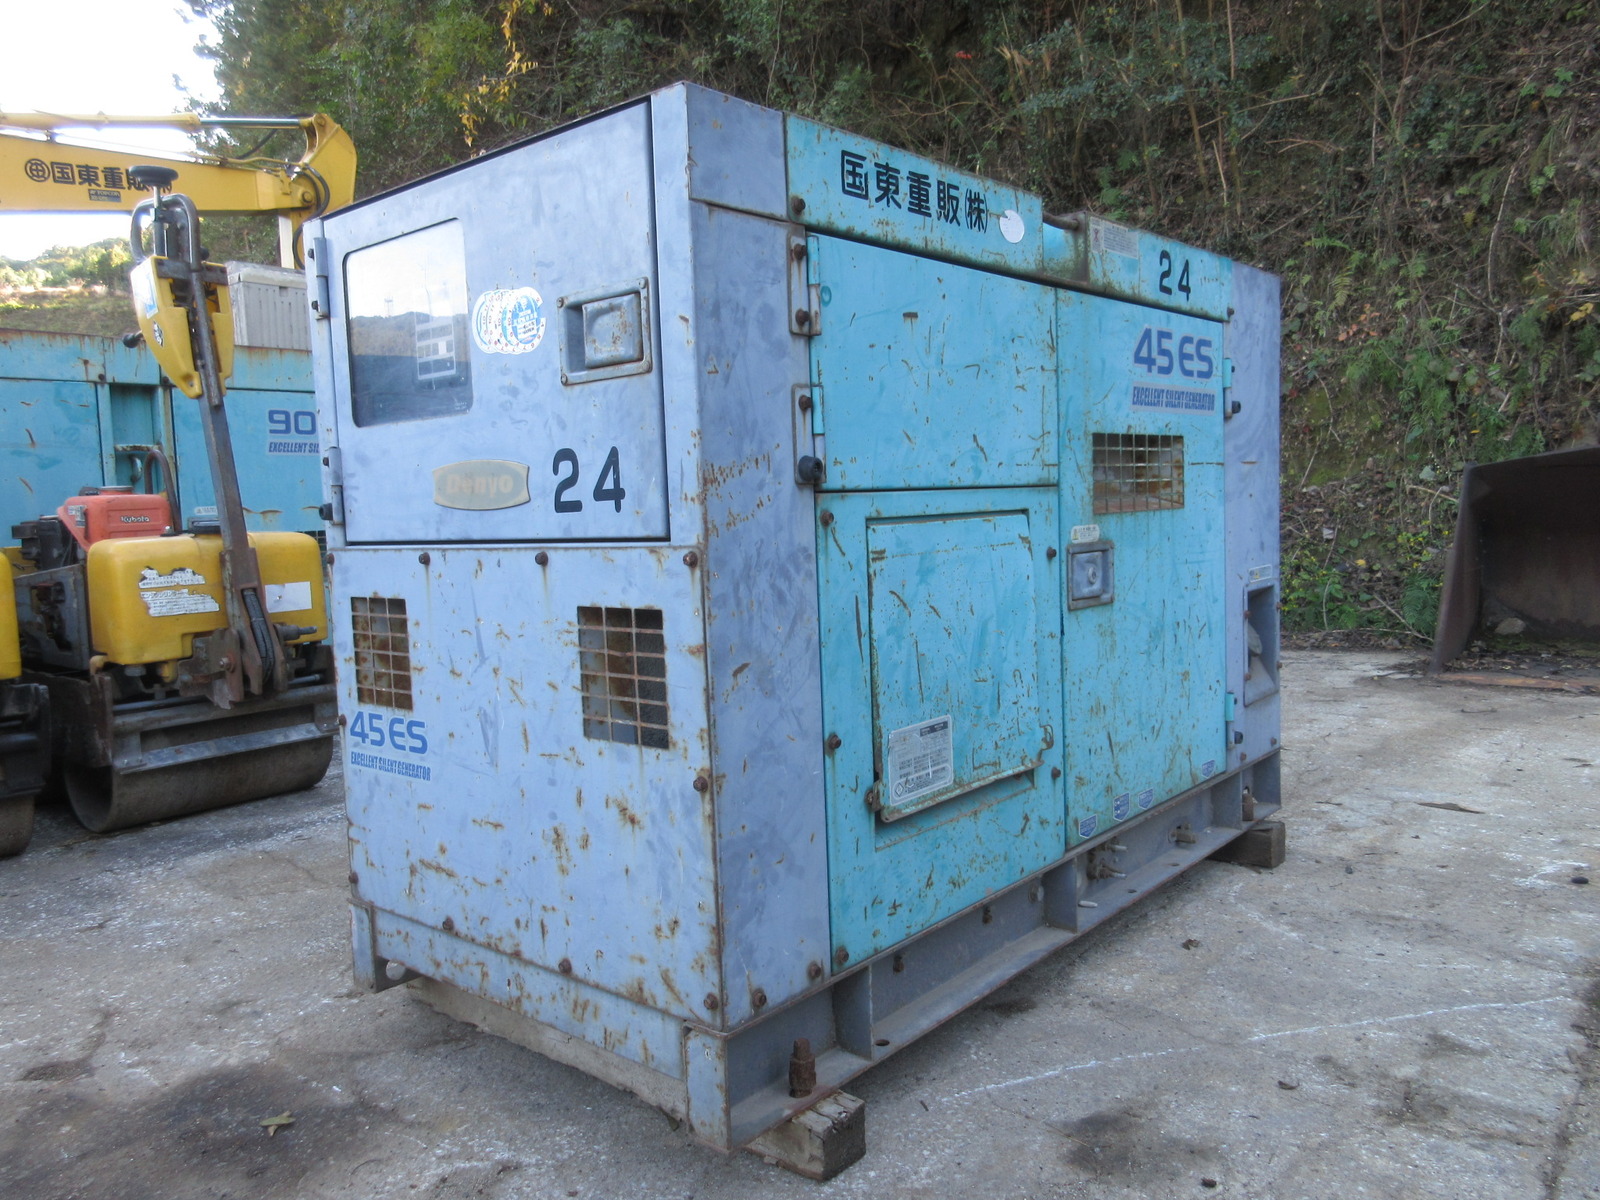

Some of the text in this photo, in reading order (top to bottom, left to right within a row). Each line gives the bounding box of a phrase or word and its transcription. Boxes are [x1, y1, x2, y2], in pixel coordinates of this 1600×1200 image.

[1158, 249, 1192, 302] 24
[1131, 386, 1216, 412] EXCELLENT SILENT GENERATOR
[268, 409, 316, 435] 90
[268, 441, 307, 454] EXCELLENT
[446, 473, 515, 498] Denyo
[552, 445, 626, 514] 24
[350, 751, 432, 782] EXCELLENT SILENT GENERATOR
